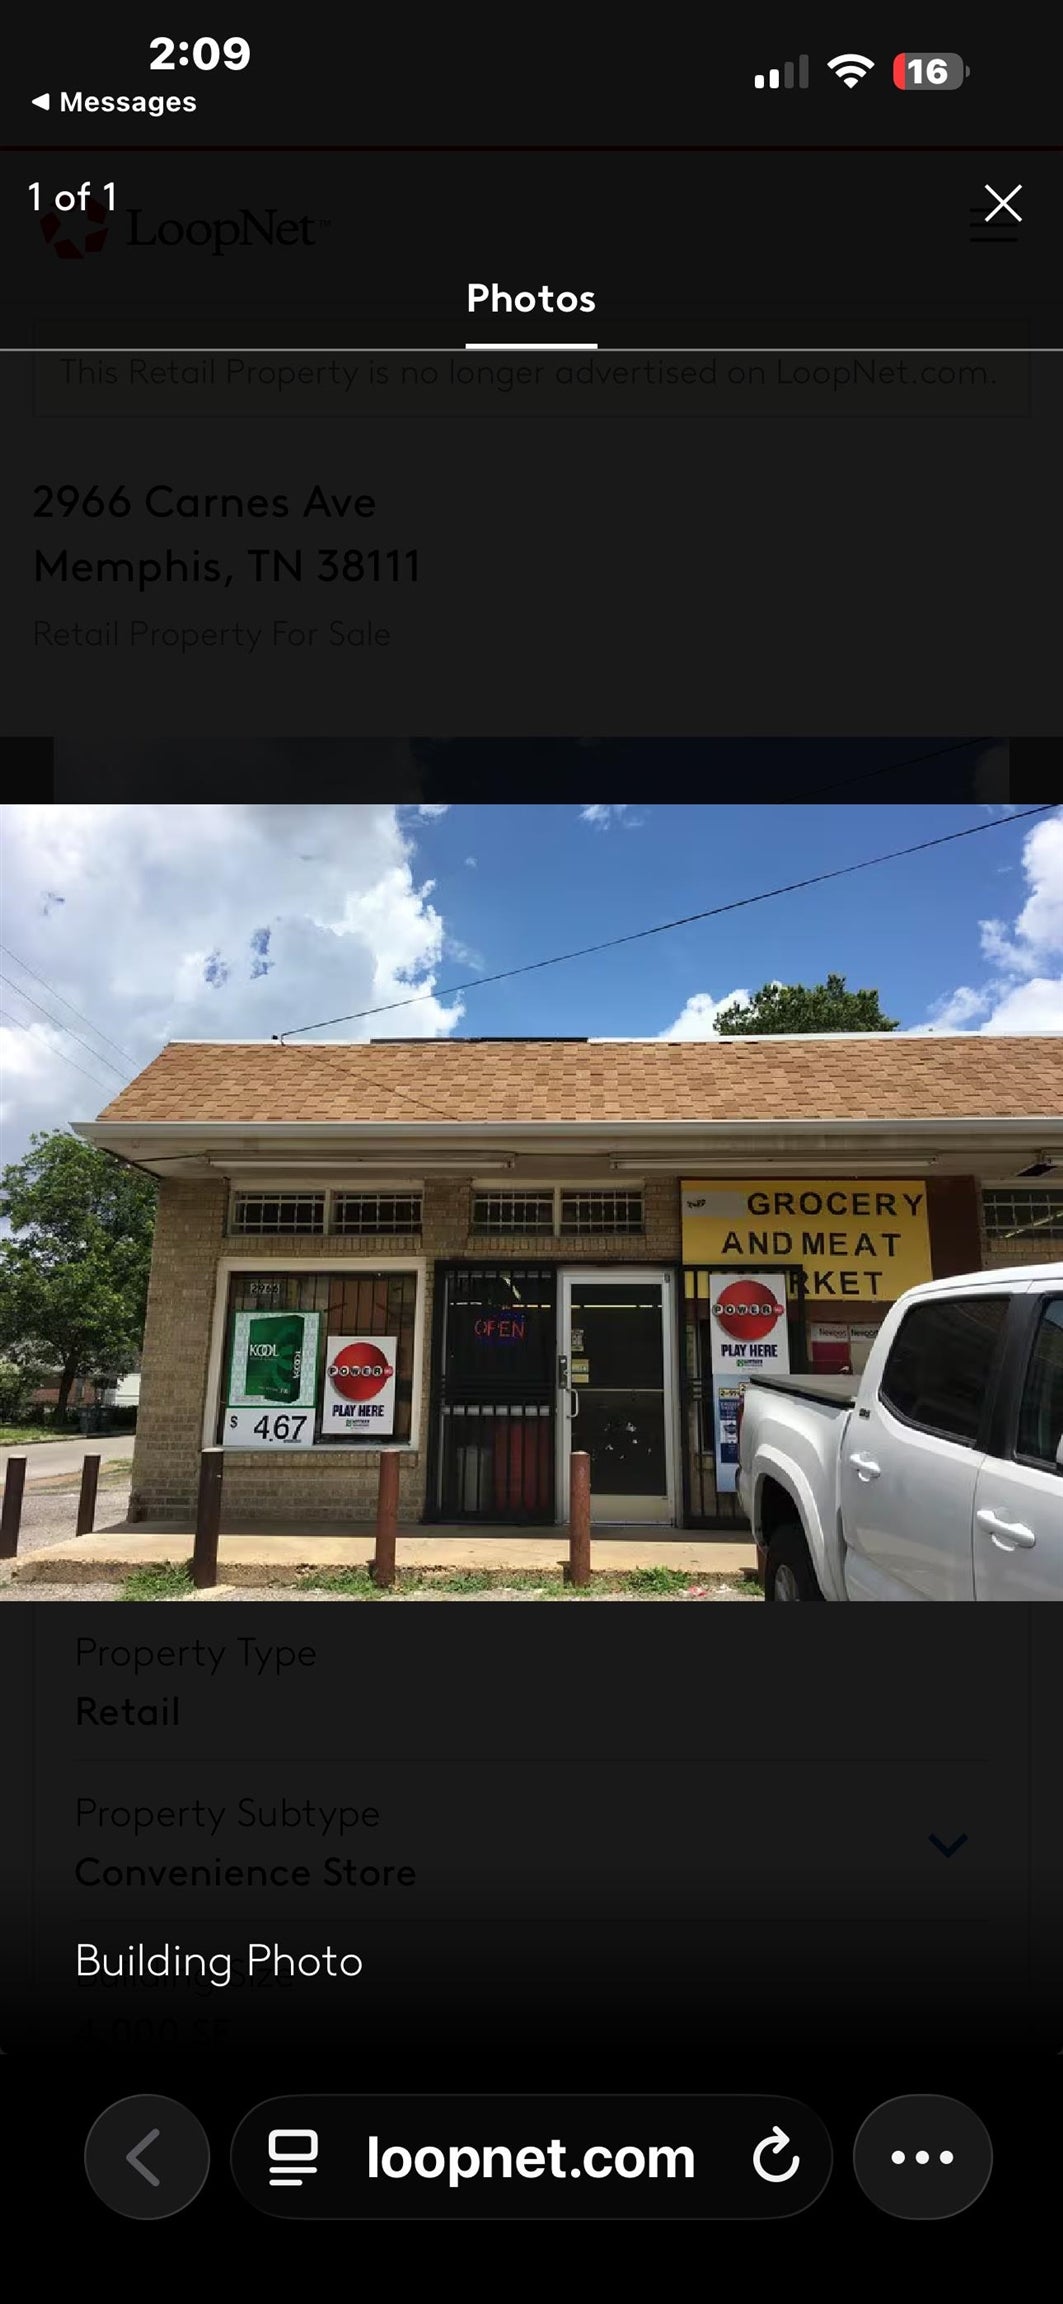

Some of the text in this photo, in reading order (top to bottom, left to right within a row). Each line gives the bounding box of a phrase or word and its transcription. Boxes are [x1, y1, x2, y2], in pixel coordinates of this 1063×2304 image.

[747, 1192, 924, 1217] GROCERY
[721, 1231, 902, 1257] AND MEAT
[789, 1271, 883, 1296] RKET
[474, 1319, 526, 1340] OPEN
[249, 1343, 279, 1357] KOOL
[721, 1344, 778, 1358] PLAY HERE
[332, 1404, 385, 1418] PLAY HERE
[230, 1414, 308, 1442] $ 4.67
